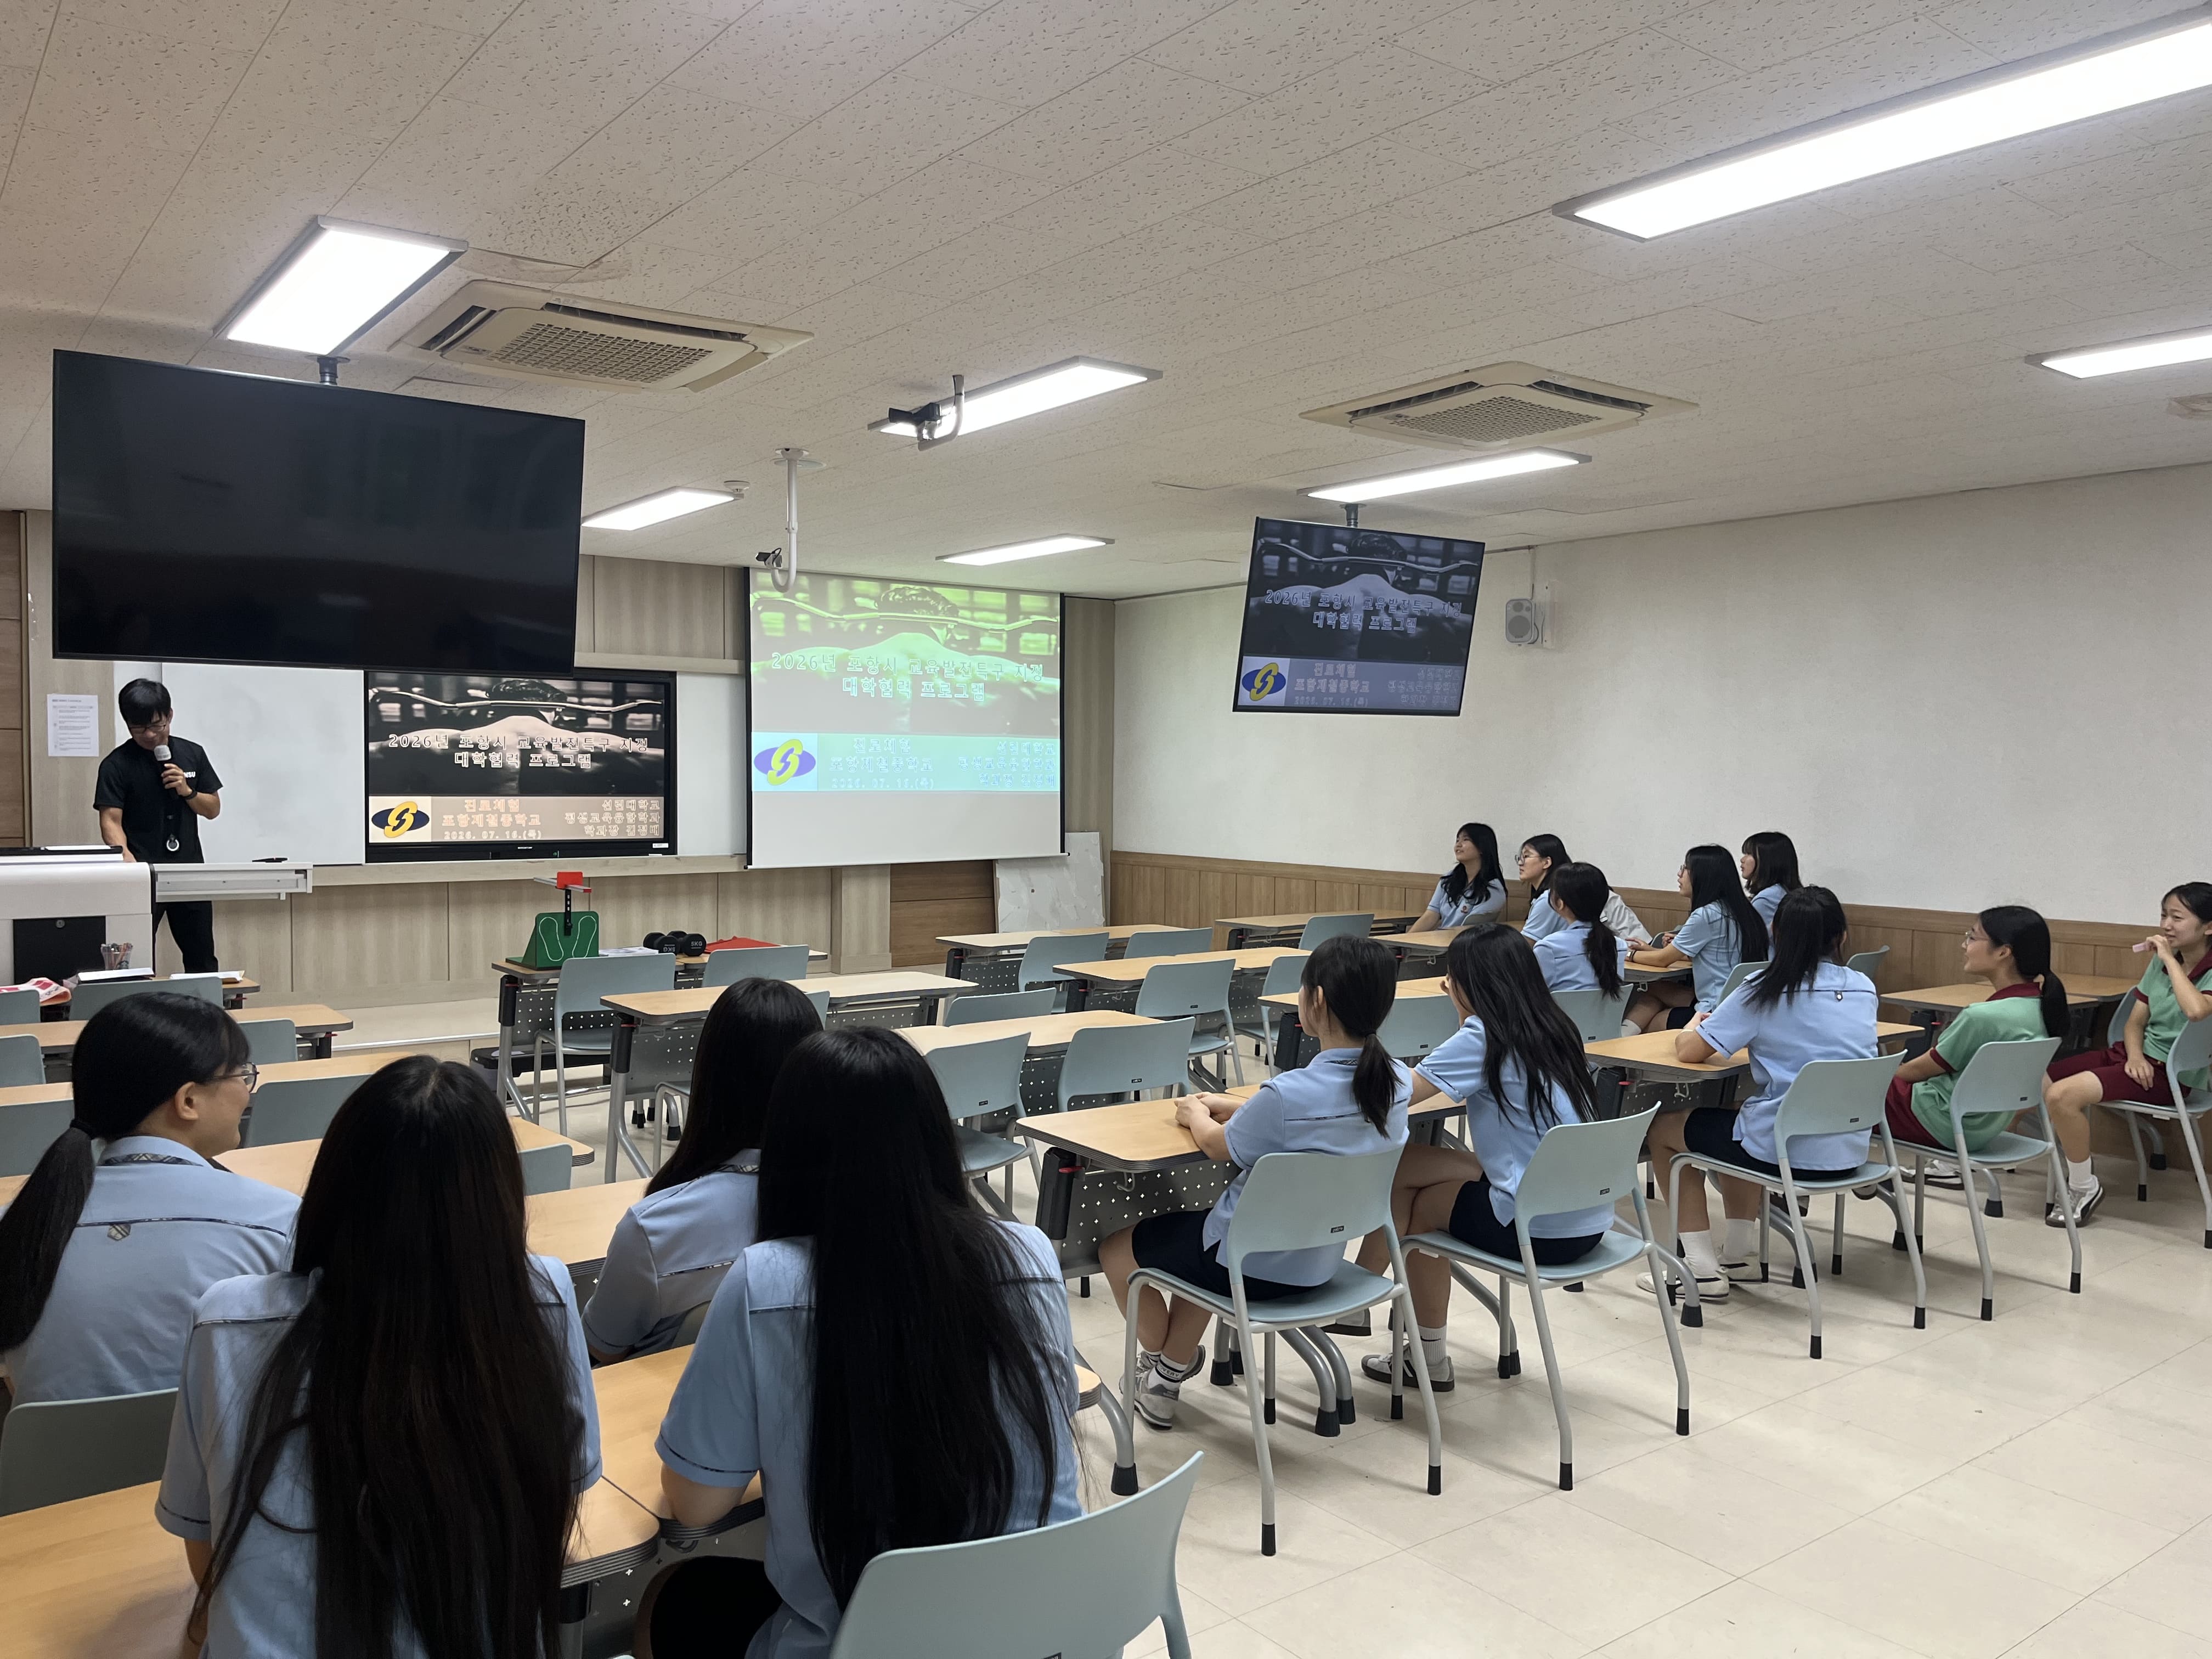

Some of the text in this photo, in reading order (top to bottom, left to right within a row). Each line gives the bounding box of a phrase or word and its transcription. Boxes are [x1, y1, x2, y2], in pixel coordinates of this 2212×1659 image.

[1265, 590, 1462, 617] 2026년 포항시 교육발전특구 지정
[1313, 612, 1417, 633] 대학협력 프로그램
[772, 652, 1043, 682] 2026년 포항시 교육발전특구 지정
[842, 676, 985, 702] 대학협력 프로그램
[388, 734, 648, 753] 2026년 포항시 교육발전특구 지정
[854, 737, 911, 754] 진로체험
[997, 741, 1055, 755] 선린대학교
[454, 752, 591, 768] 대학협력 프로그램
[830, 756, 933, 772] 포항제철중학교
[872, 778, 889, 788] 07.
[979, 773, 1013, 787] 학과장
[602, 799, 659, 811] 선린대학교
[442, 814, 541, 827] 포항제철중학교
[565, 812, 661, 824] 평생교육융합학과
[482, 831, 499, 839] 07.
[584, 825, 619, 837] 학과장
